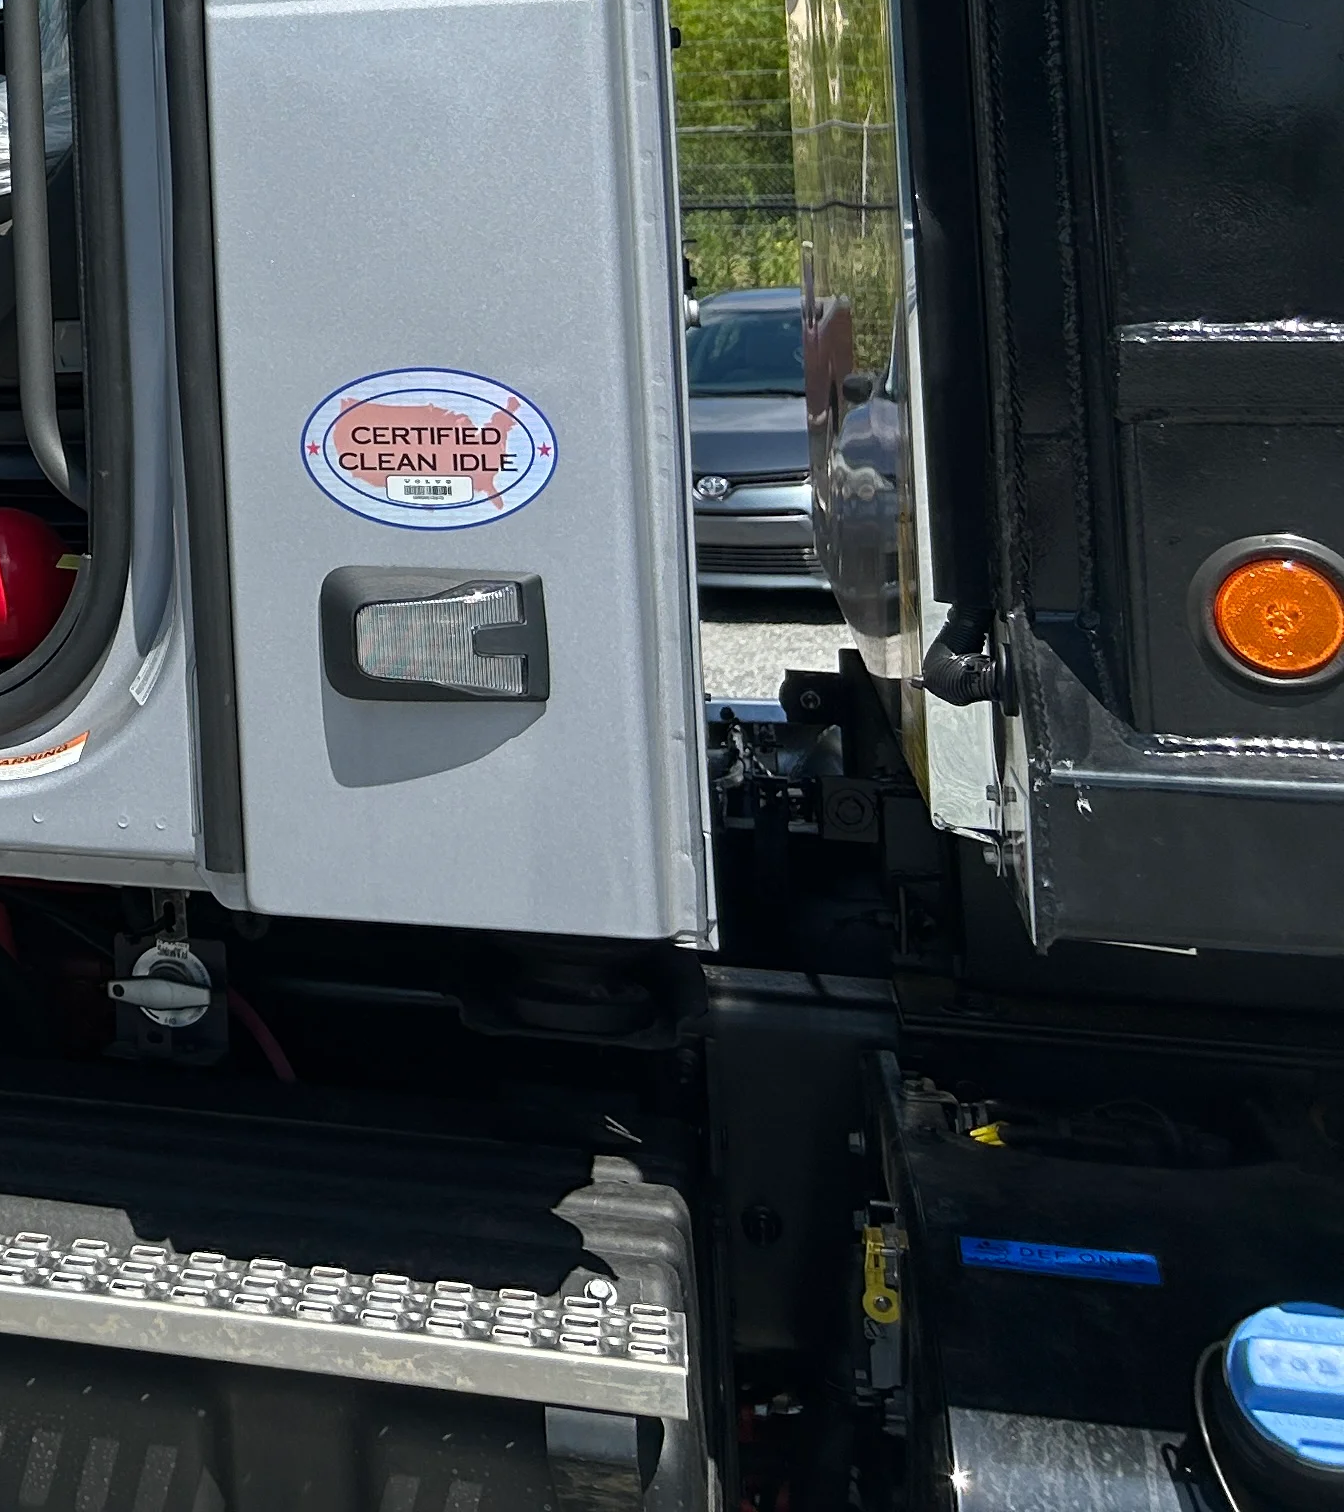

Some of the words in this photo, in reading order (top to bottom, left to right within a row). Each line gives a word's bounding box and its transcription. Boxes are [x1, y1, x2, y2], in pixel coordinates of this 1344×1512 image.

[351, 427, 501, 445] CERTIFIED
[339, 452, 437, 472] CLEAN
[453, 453, 518, 472] IDLE
[1019, 1247, 1066, 1260] DEF
